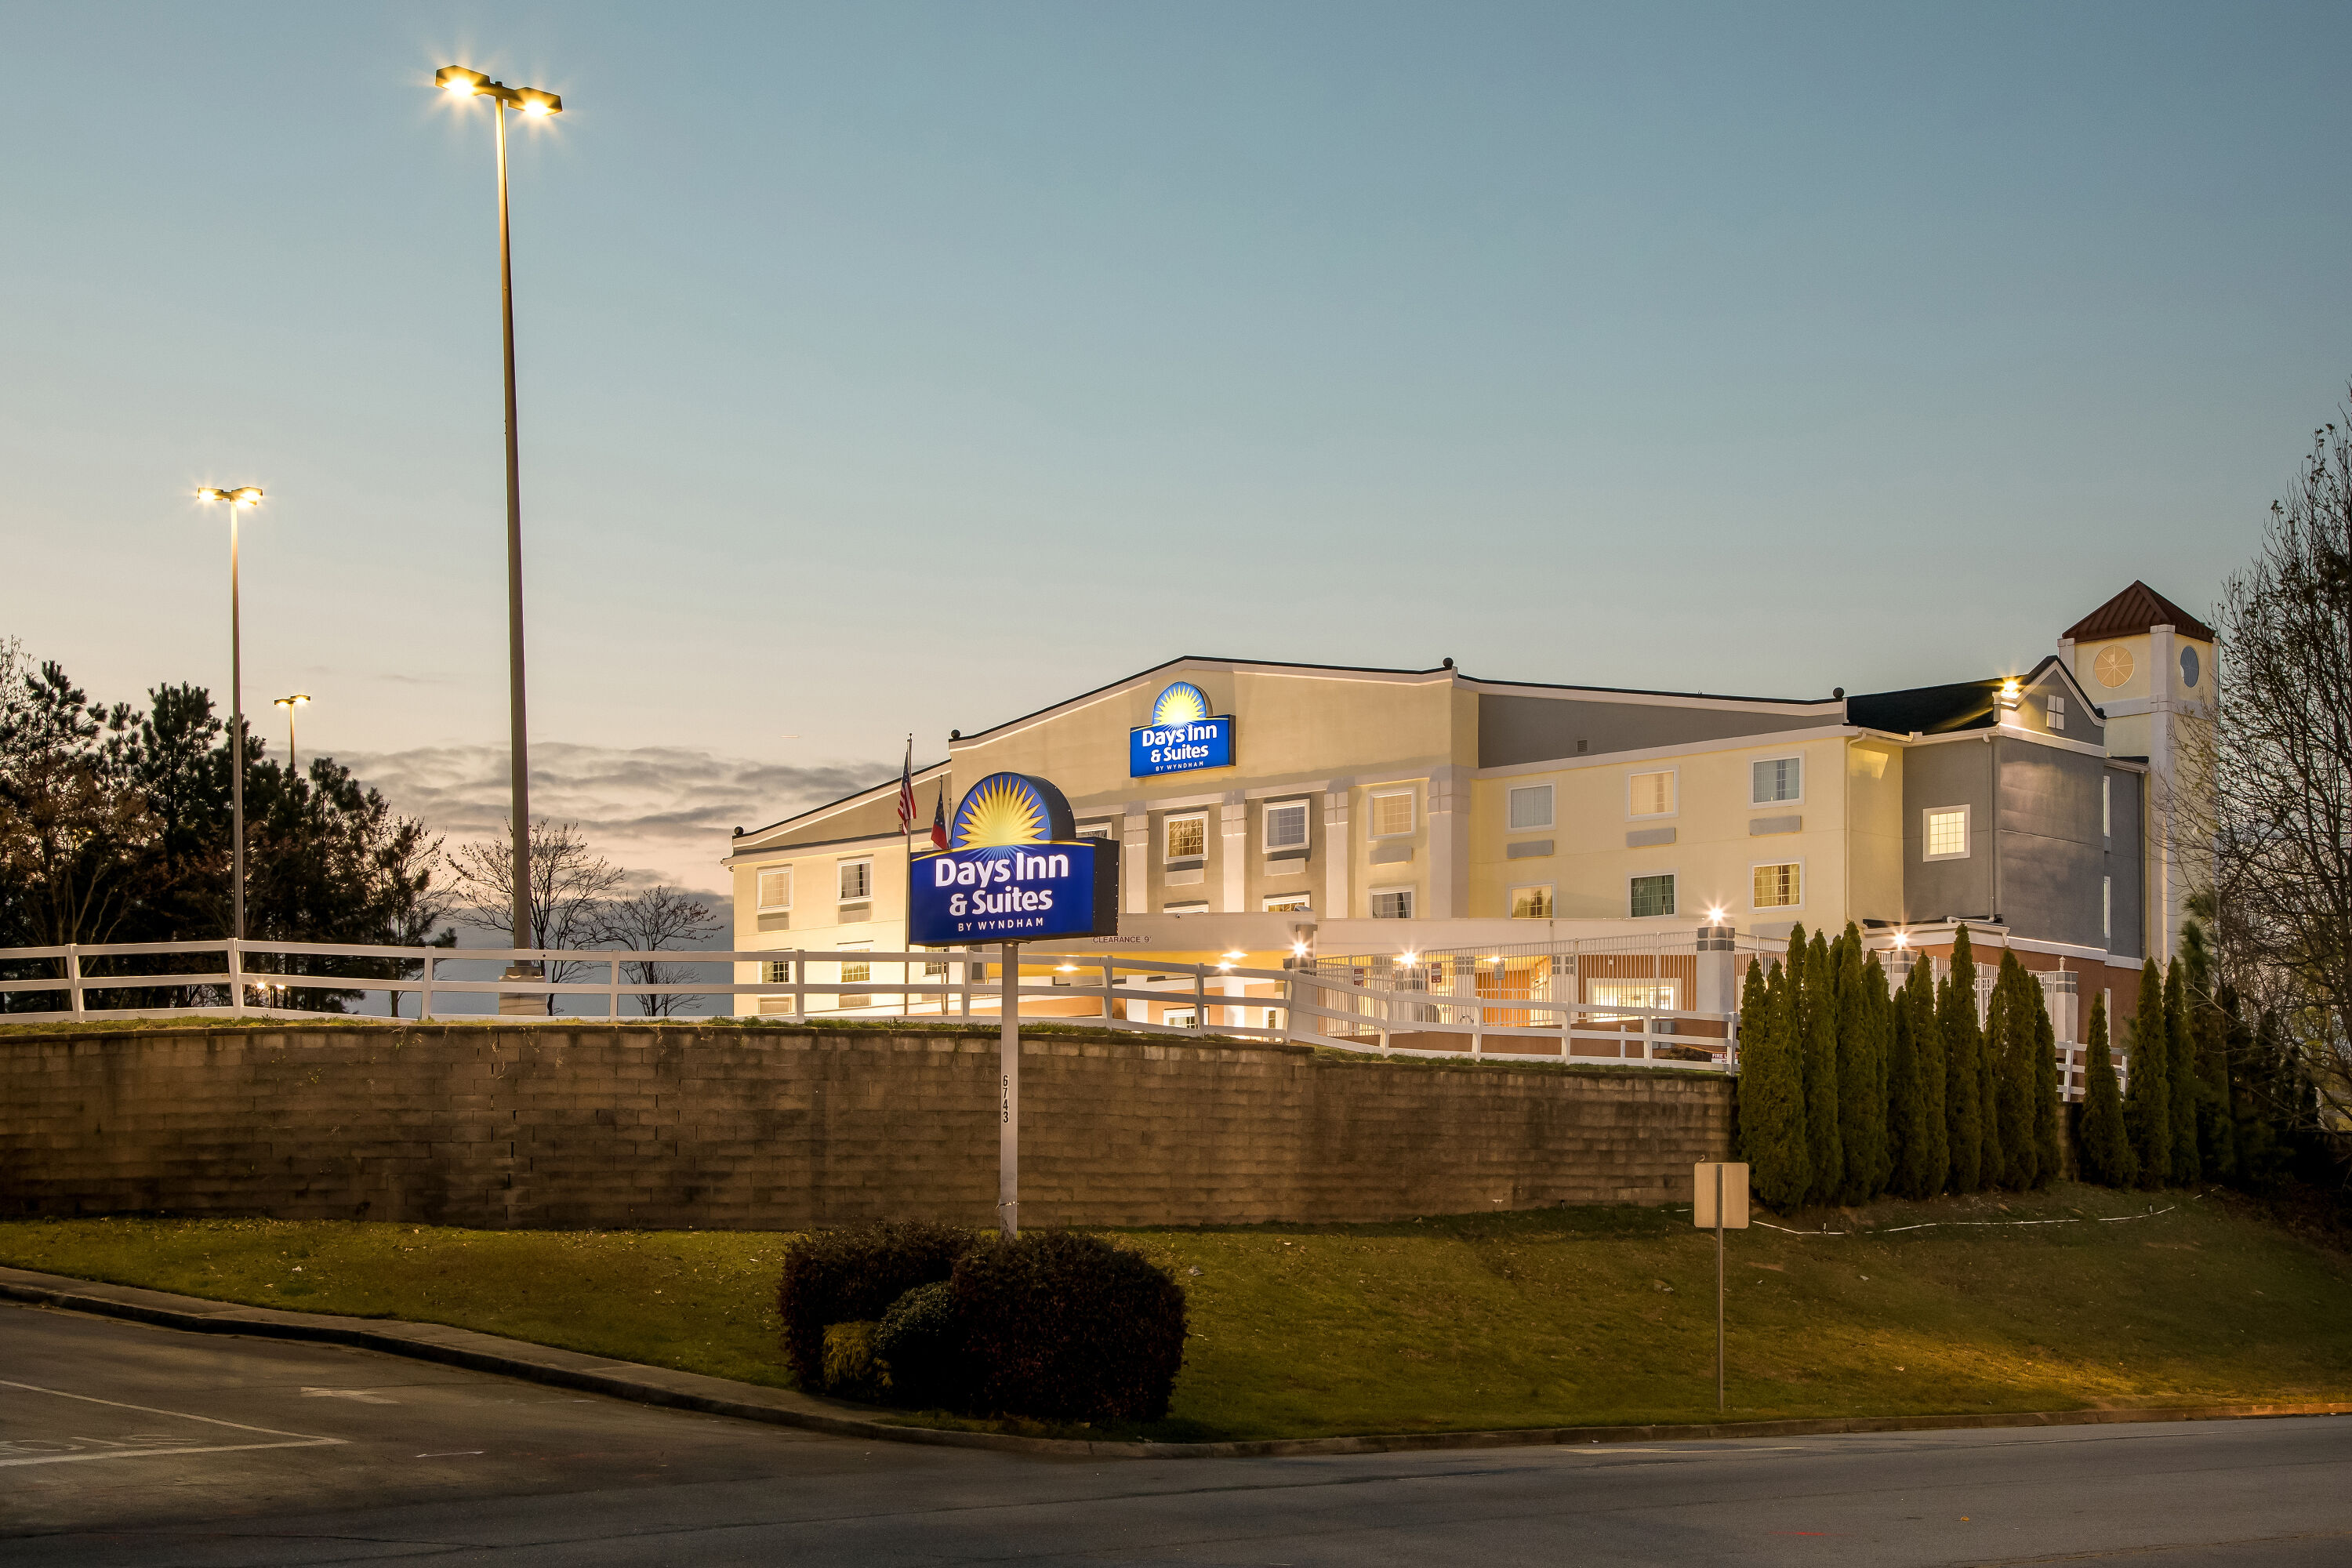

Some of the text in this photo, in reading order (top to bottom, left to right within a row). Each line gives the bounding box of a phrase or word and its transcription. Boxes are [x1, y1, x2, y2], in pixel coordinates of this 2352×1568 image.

[1142, 725, 1217, 746] Days Inn
[1150, 744, 1209, 763] & Suites
[1167, 761, 1203, 770] WYNDHAM
[935, 852, 1069, 888] Days Inn
[949, 886, 1053, 916] & Suites
[958, 917, 1044, 932] BY WYNDHAM
